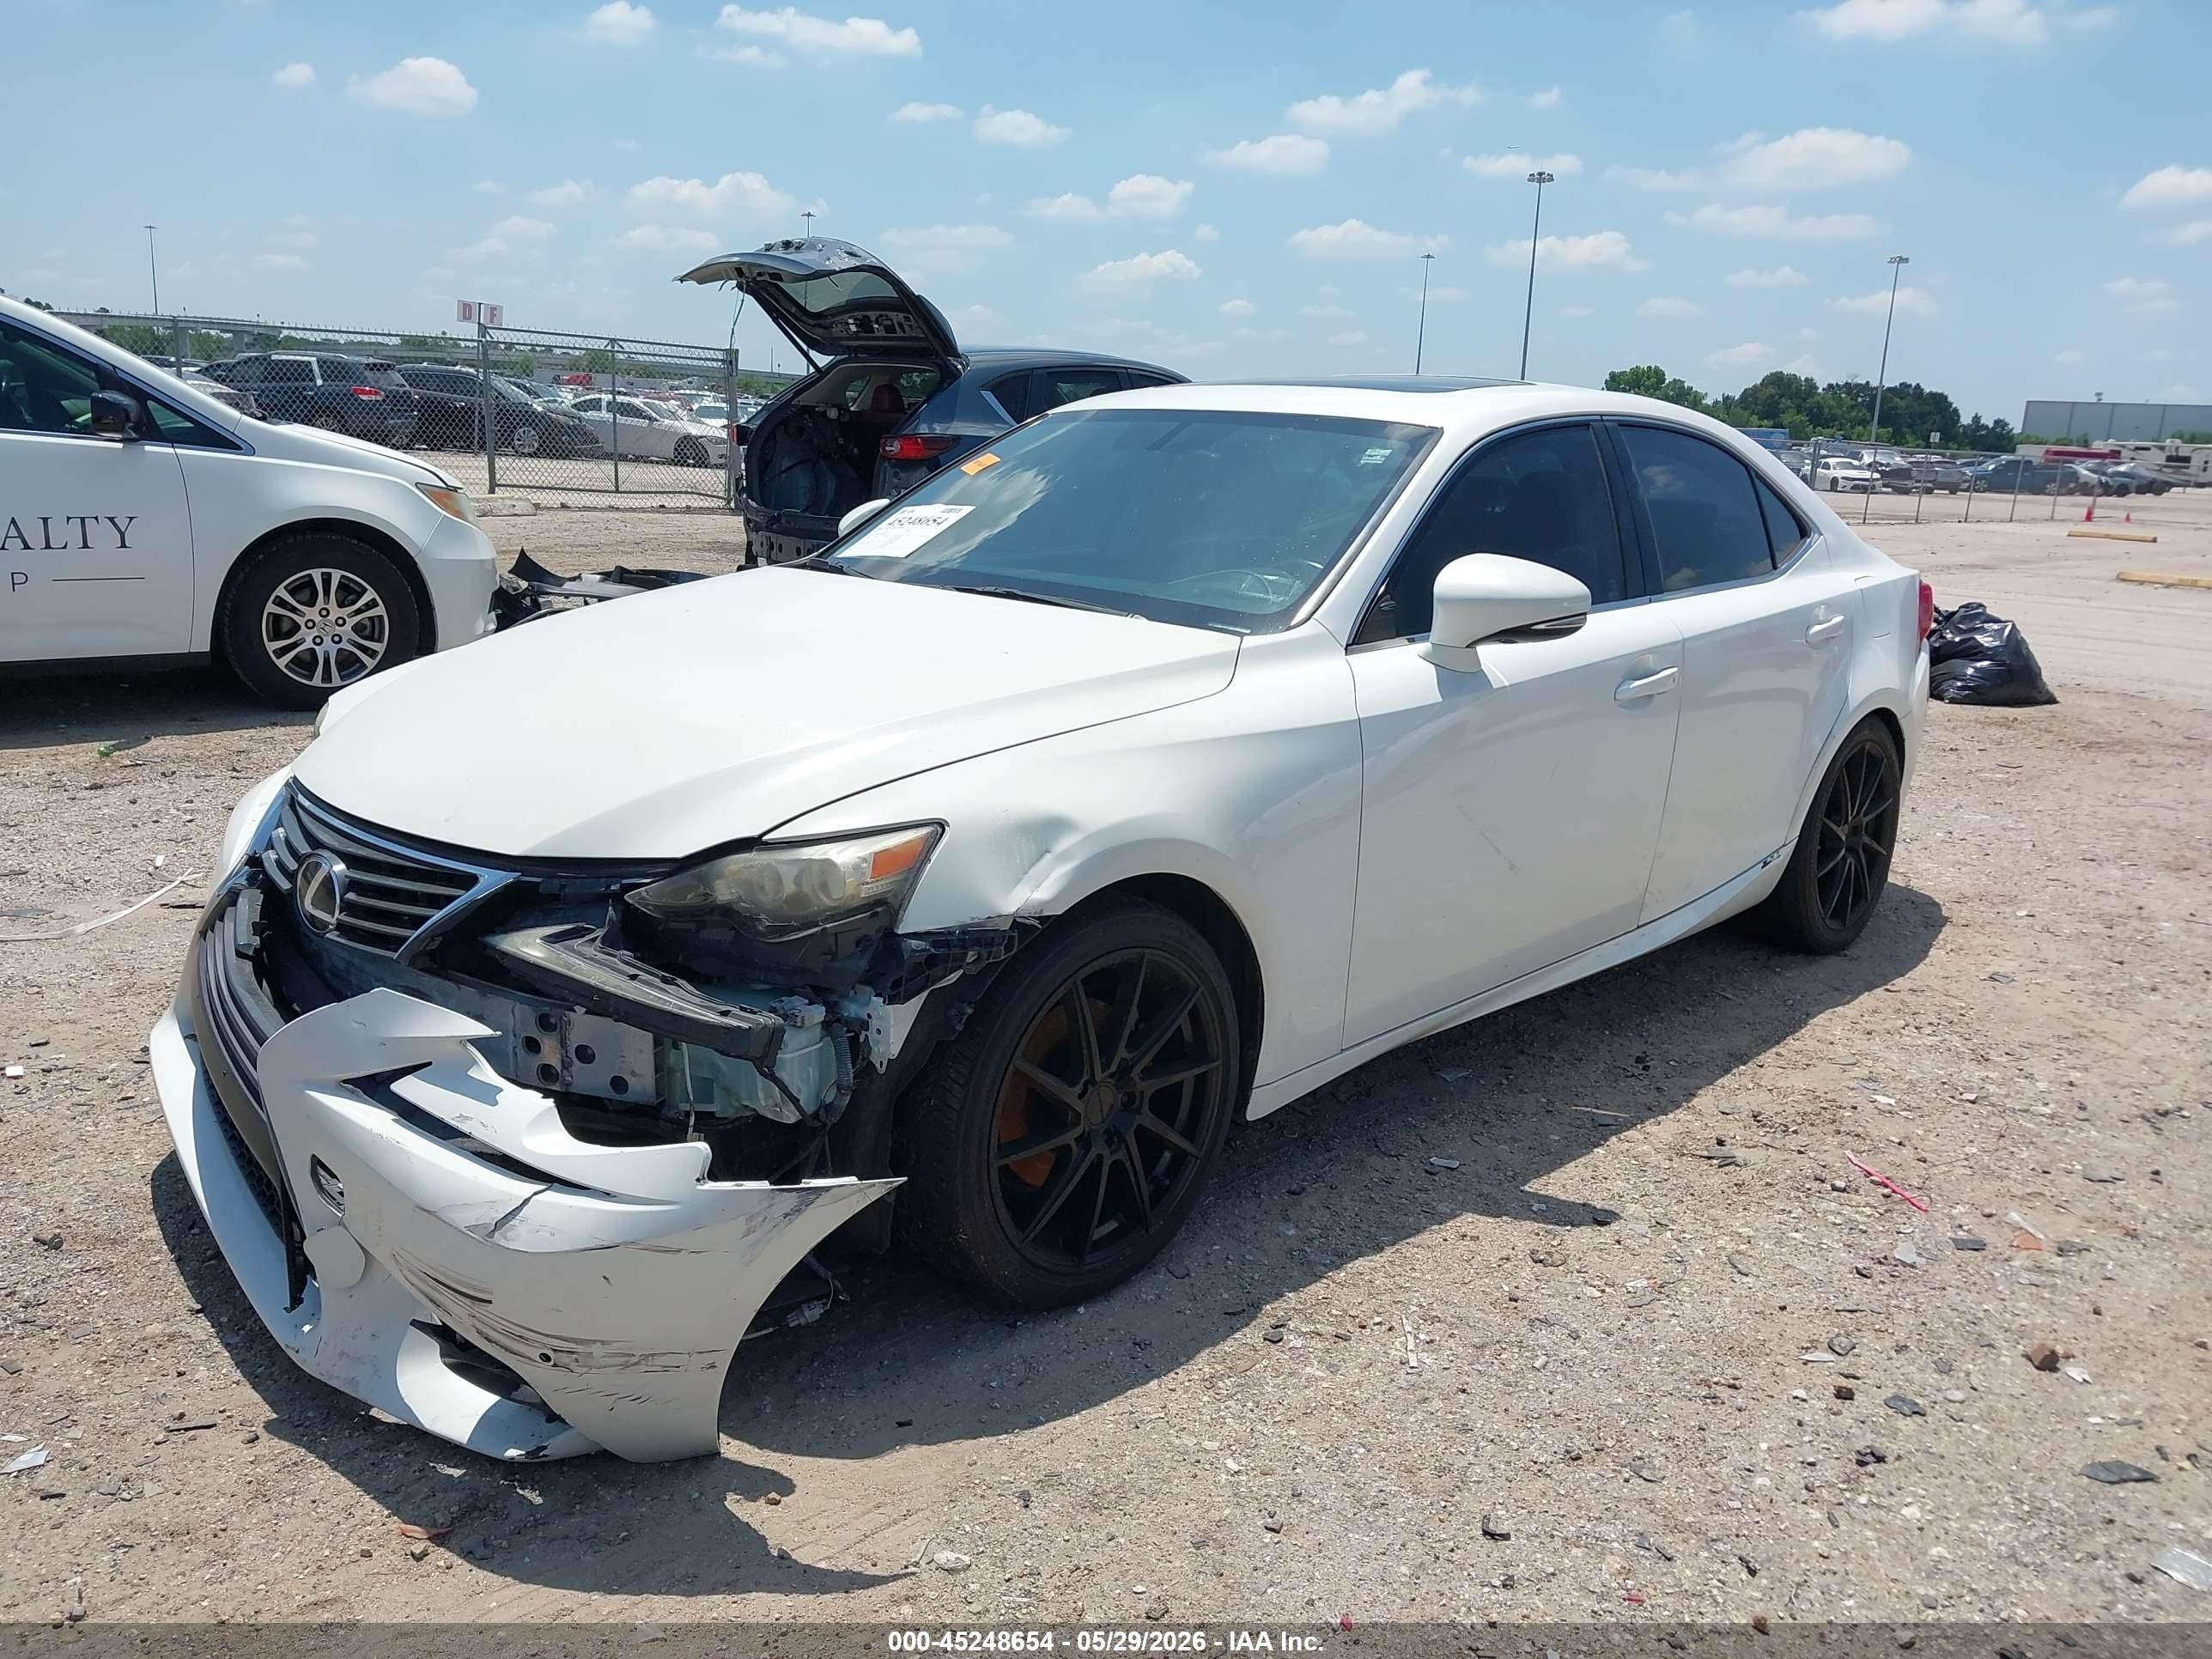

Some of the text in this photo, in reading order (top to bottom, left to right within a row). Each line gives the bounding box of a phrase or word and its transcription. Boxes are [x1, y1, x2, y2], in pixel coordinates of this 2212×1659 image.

[462, 302, 498, 324] D F
[0, 514, 138, 551] ALTY
